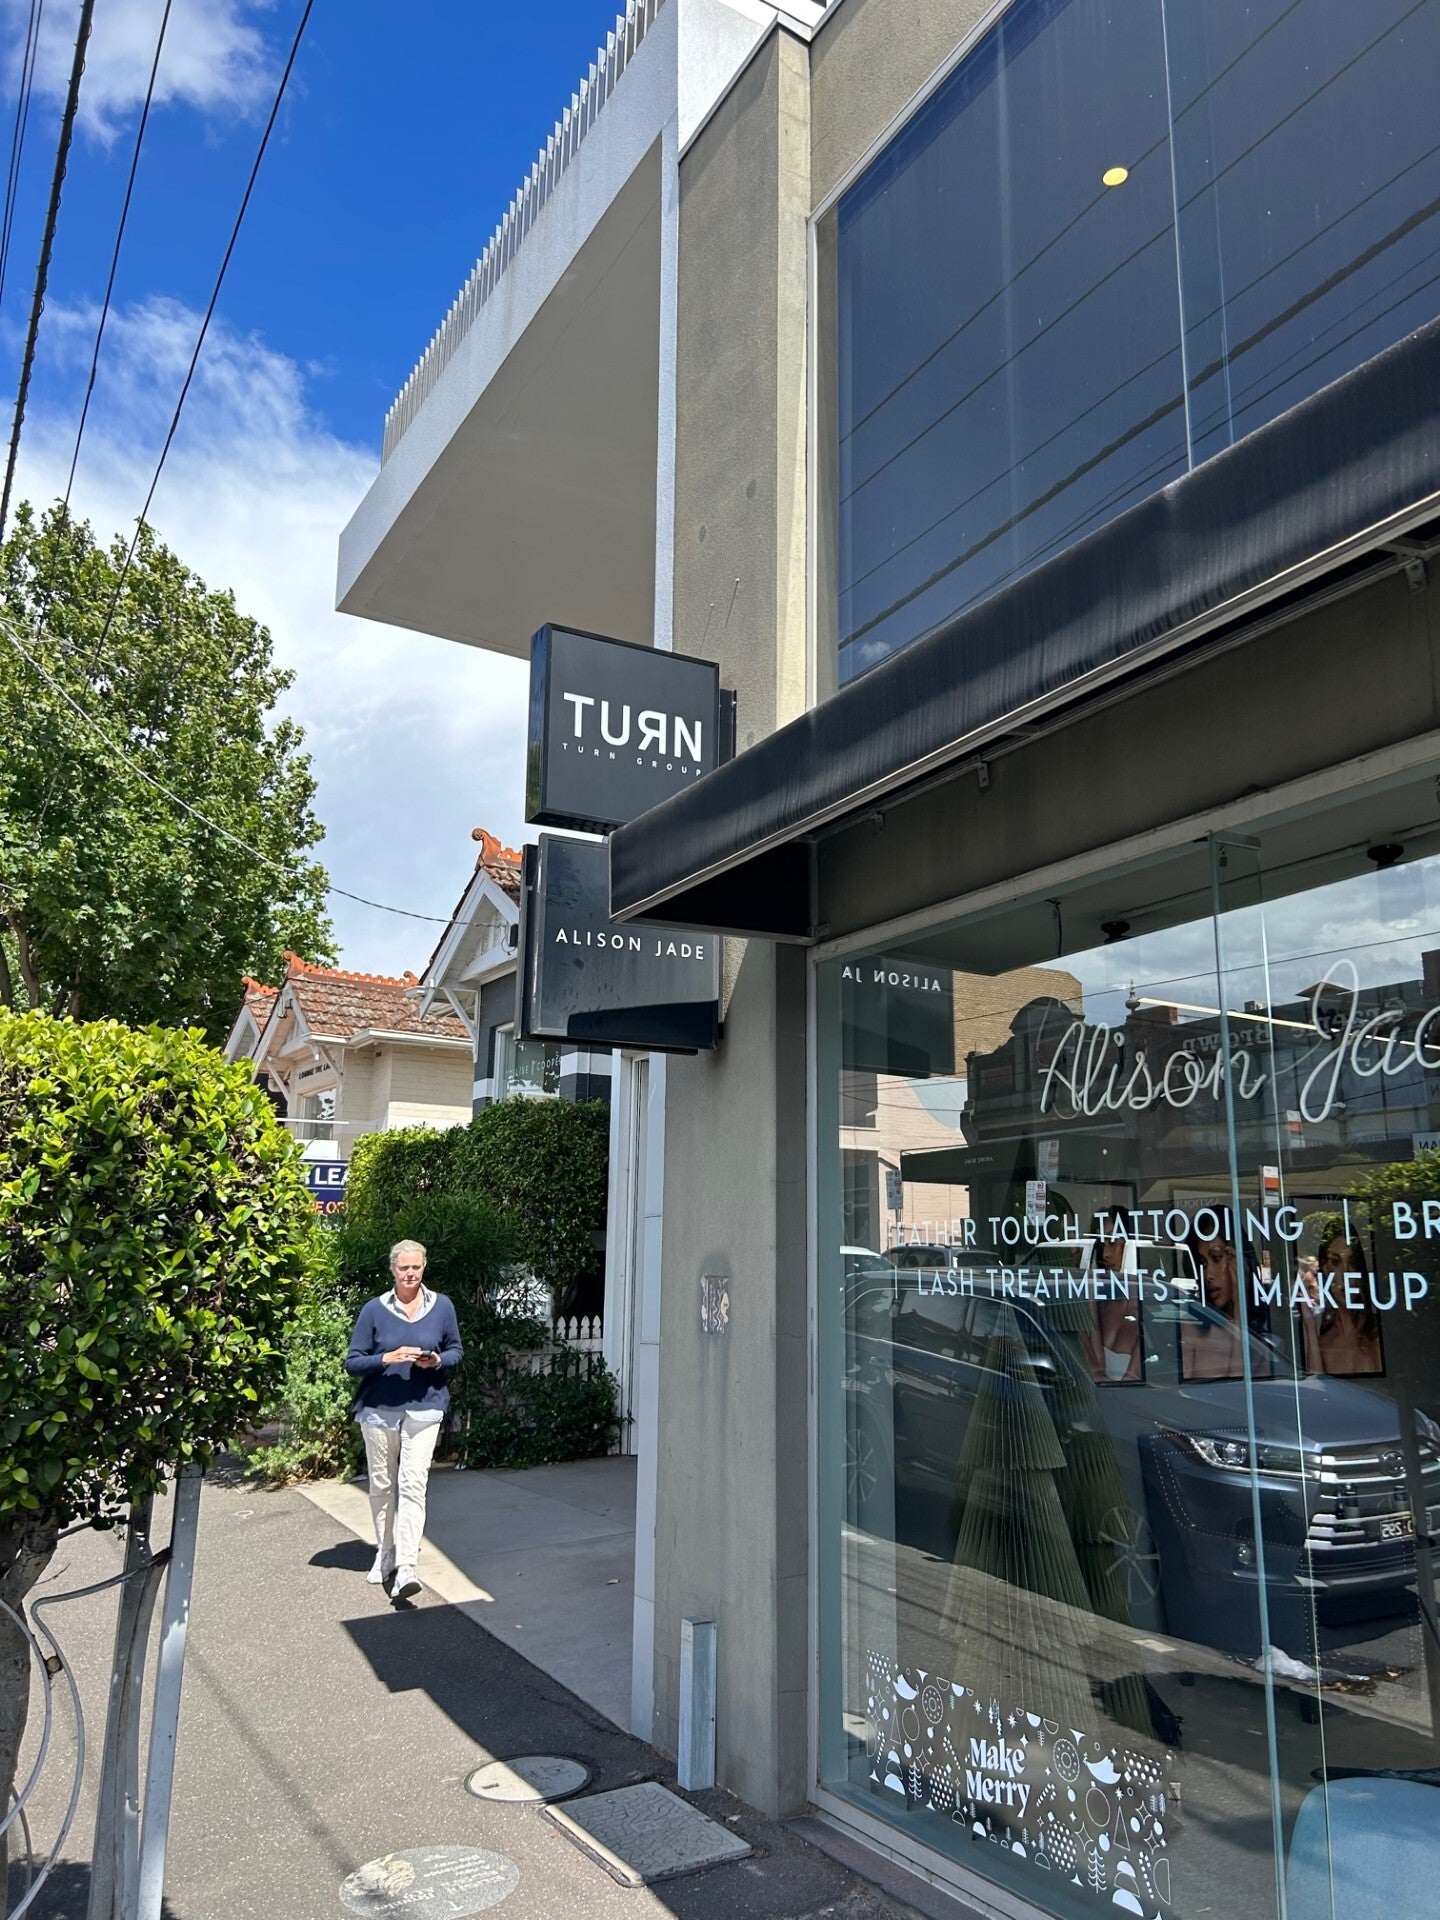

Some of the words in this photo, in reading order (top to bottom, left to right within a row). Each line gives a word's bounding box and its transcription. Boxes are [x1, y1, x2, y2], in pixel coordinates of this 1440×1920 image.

[562, 742, 616, 760] TURN
[636, 757, 702, 777] GROUP
[555, 927, 641, 952] ALISON
[655, 940, 704, 960] JADE
[1037, 1020, 1268, 1116] Alison
[887, 1217, 977, 1247] FEATHER
[988, 1213, 1080, 1246] TOUCH
[1094, 1205, 1304, 1243] TATTOOING
[918, 1268, 975, 1297] LASH
[985, 1268, 1169, 1302] TREATMENTS
[1252, 1271, 1429, 1311] MAKEUP
[969, 1737, 1026, 1778] Make
[965, 1769, 1031, 1819] Merry
